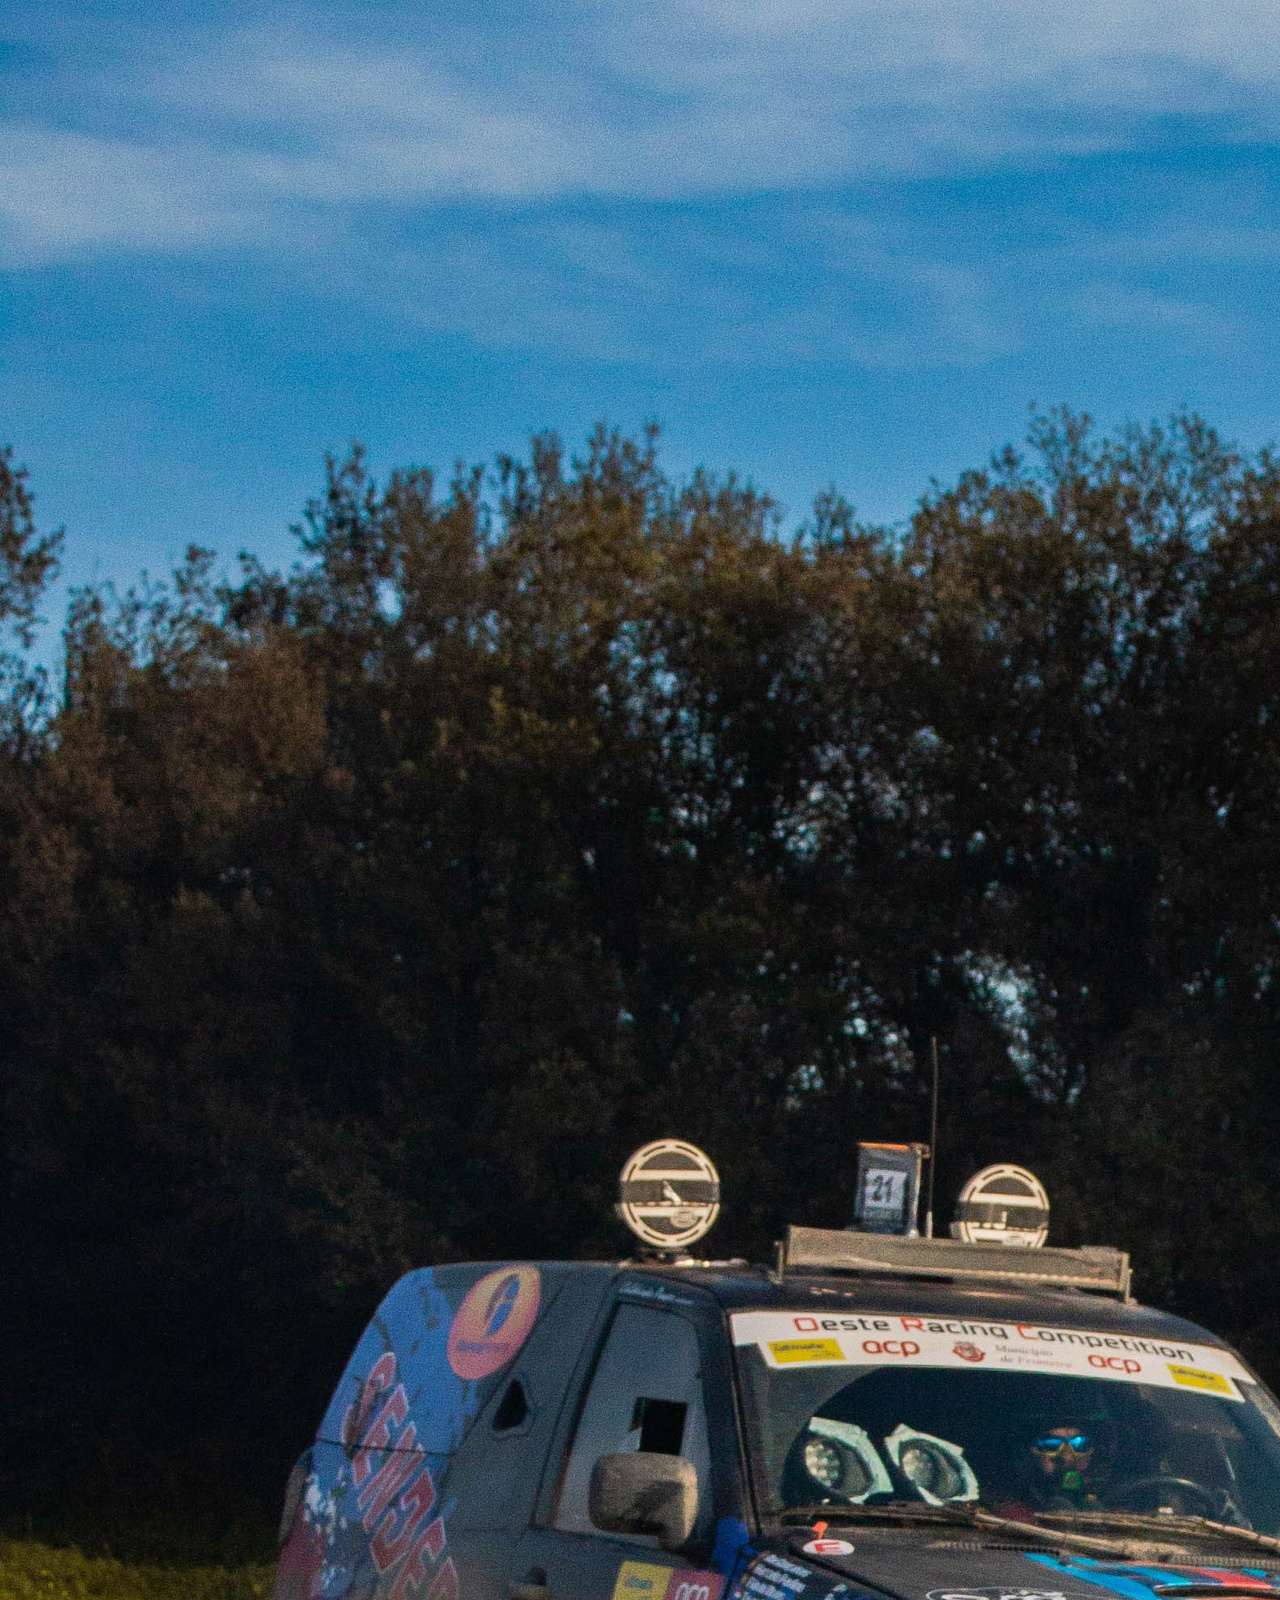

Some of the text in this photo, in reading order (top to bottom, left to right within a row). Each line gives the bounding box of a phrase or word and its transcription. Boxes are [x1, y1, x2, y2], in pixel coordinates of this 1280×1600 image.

[872, 1174, 894, 1203] 21
[793, 1317, 1195, 1362] Oeste Racing Competition
[862, 1340, 920, 1357] acp
[1088, 1354, 1142, 1374] acp
